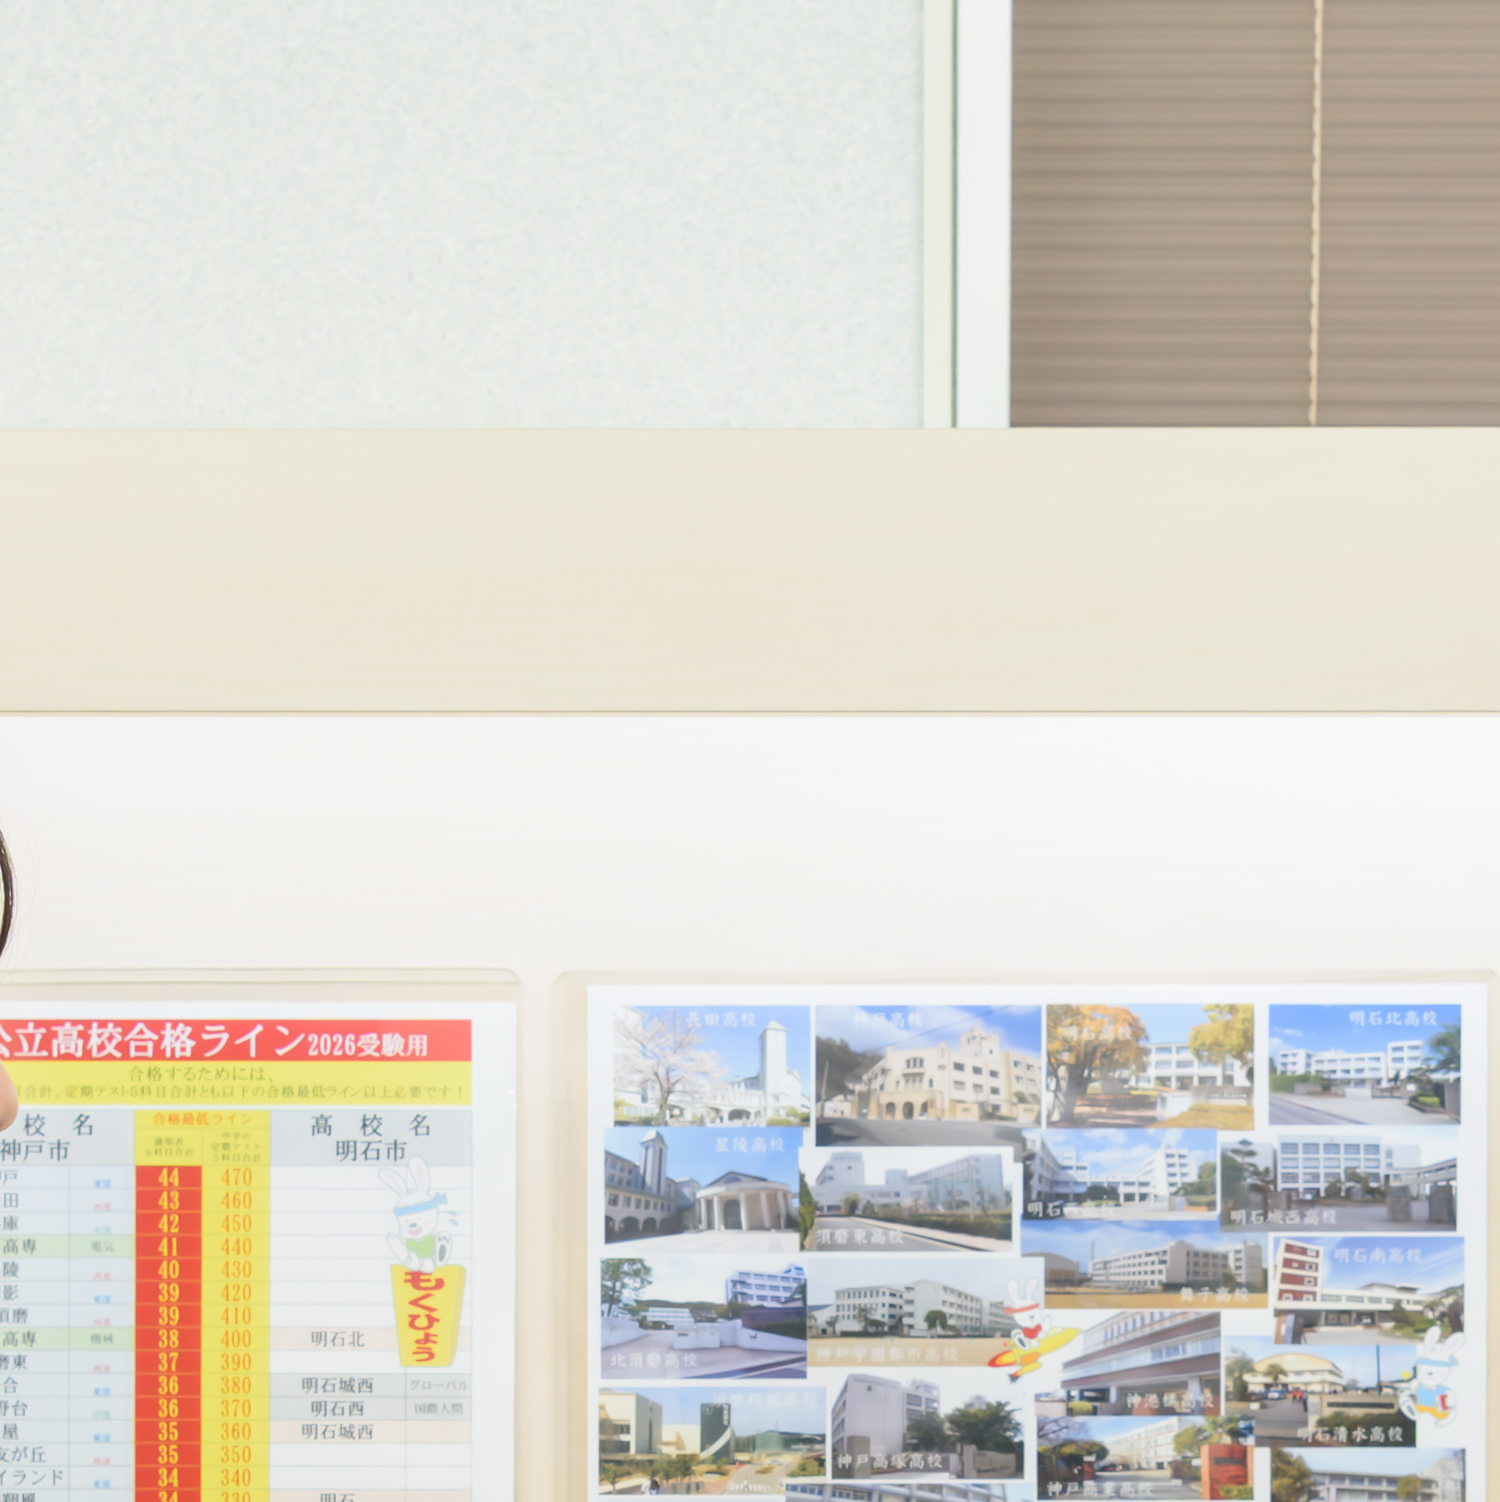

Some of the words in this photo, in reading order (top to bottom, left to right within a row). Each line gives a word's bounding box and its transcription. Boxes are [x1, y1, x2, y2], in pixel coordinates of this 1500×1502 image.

[1349, 1010, 1438, 1027] 明石北高校
[126, 1064, 276, 1084] 合格するためには、
[334, 1137, 408, 1164] 明石市
[715, 1137, 786, 1154] 星陵高校
[157, 1168, 181, 1186] 44
[221, 1168, 253, 1186] 470
[157, 1191, 181, 1210] 43
[221, 1191, 253, 1210] 460
[157, 1214, 181, 1233] 42
[221, 1214, 253, 1233] 450
[157, 1237, 181, 1256] 41
[221, 1237, 253, 1256] 440
[1334, 1248, 1422, 1263] 明石南高校
[157, 1260, 181, 1279] 40
[221, 1260, 253, 1279] 430
[157, 1283, 181, 1302] 39
[221, 1283, 253, 1302] 420
[157, 1306, 181, 1325] 39
[221, 1306, 253, 1325] 410
[157, 1329, 181, 1348] 38
[221, 1329, 253, 1348] 400
[310, 1330, 365, 1348] 明石北
[157, 1352, 181, 1371] 37
[221, 1352, 253, 1371] 390
[157, 1375, 181, 1394] 36
[221, 1375, 253, 1394] 380
[301, 1376, 374, 1395] 明石城西
[410, 1379, 468, 1391] グローバル
[157, 1398, 181, 1417] 36
[221, 1398, 253, 1417] 370
[310, 1400, 364, 1418] 明石西
[157, 1421, 181, 1440] 35
[221, 1421, 253, 1440] 360
[301, 1423, 373, 1441] 明石城西
[157, 1444, 181, 1463] 35
[221, 1444, 253, 1463] 350
[837, 1453, 943, 1470] 神戸高塚高校
[157, 1468, 181, 1487] 34
[221, 1468, 253, 1487] 340
